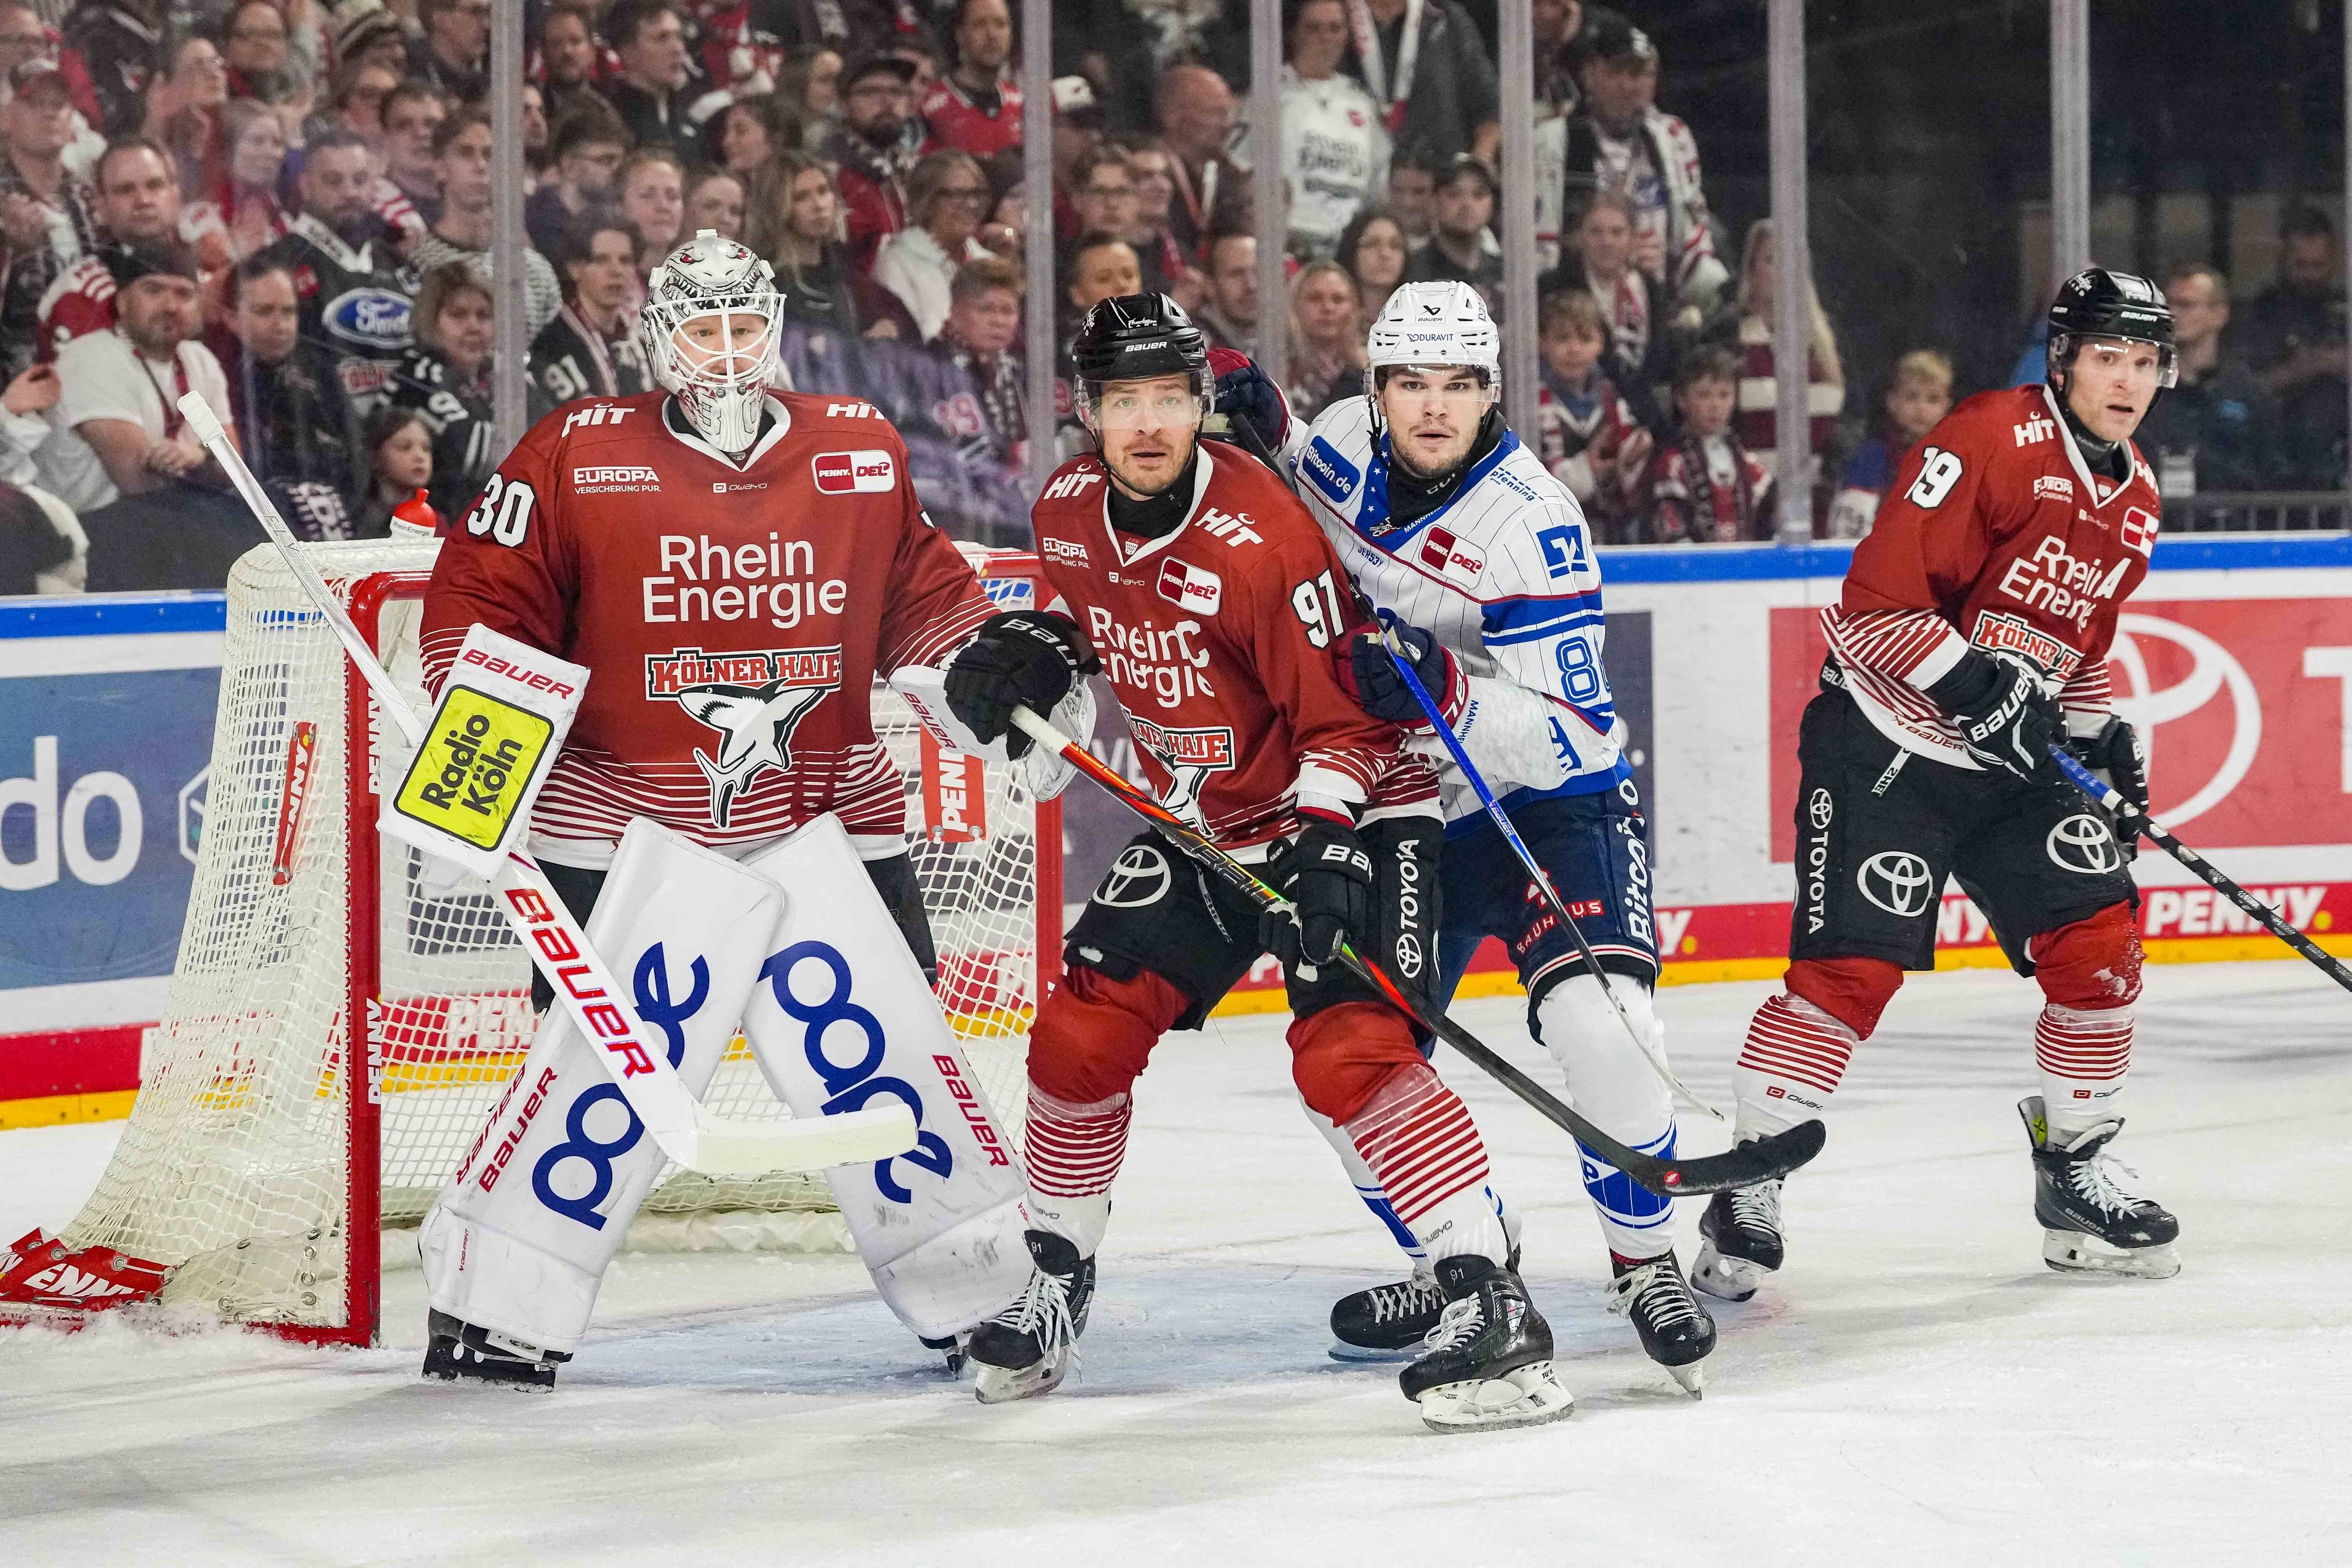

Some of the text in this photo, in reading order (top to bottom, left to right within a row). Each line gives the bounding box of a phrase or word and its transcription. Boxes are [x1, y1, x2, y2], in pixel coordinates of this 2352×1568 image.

[2121, 311, 2158, 322] BAUER
[1125, 341, 1167, 352] BAUER
[562, 403, 635, 437] HIT
[2013, 411, 2054, 447] HIT
[573, 466, 660, 483] EUROPA
[574, 485, 640, 494] VERSICHERUNG
[856, 462, 890, 477] DEL
[1043, 463, 1102, 499] HIT
[1305, 445, 1352, 494] Bitcoin.de
[1489, 470, 1536, 502] pfenning
[1904, 446, 1962, 509] 19
[467, 472, 535, 548] 30
[1194, 507, 1264, 547] HIT
[1404, 504, 1443, 534] MANNHEIM
[660, 531, 814, 581] Rhein
[1449, 552, 1483, 575] DEL
[2093, 557, 2132, 600] A
[643, 576, 847, 629] Energie
[1184, 581, 1217, 600] DEL
[1292, 568, 1345, 649] 91
[1175, 619, 1210, 668] C
[1977, 617, 2059, 665] KÖLNER
[461, 648, 574, 700] BAUER
[649, 649, 841, 694] KÖLNER HAIE
[903, 692, 957, 749] BAUER
[1970, 667, 2033, 743] BAUER
[1168, 733, 1228, 763] HAIE
[1905, 726, 1964, 751] BAUER
[420, 714, 490, 810] Radio
[462, 738, 523, 817] Köln
[1491, 806, 1515, 837] BAUER
[1269, 845, 1284, 862] BAUER
[1395, 840, 1420, 930] TOYOTA
[1808, 831, 1829, 936] TOYOTA
[1516, 900, 1602, 955] BAUHUS
[504, 888, 657, 1081] BAUER
[366, 997, 382, 1106] PENNY
[478, 1066, 558, 1193] BAUER
[931, 1054, 1010, 1167] BAUER
[1031, 1241, 1042, 1254] 91
[1449, 1267, 1465, 1281] 91
